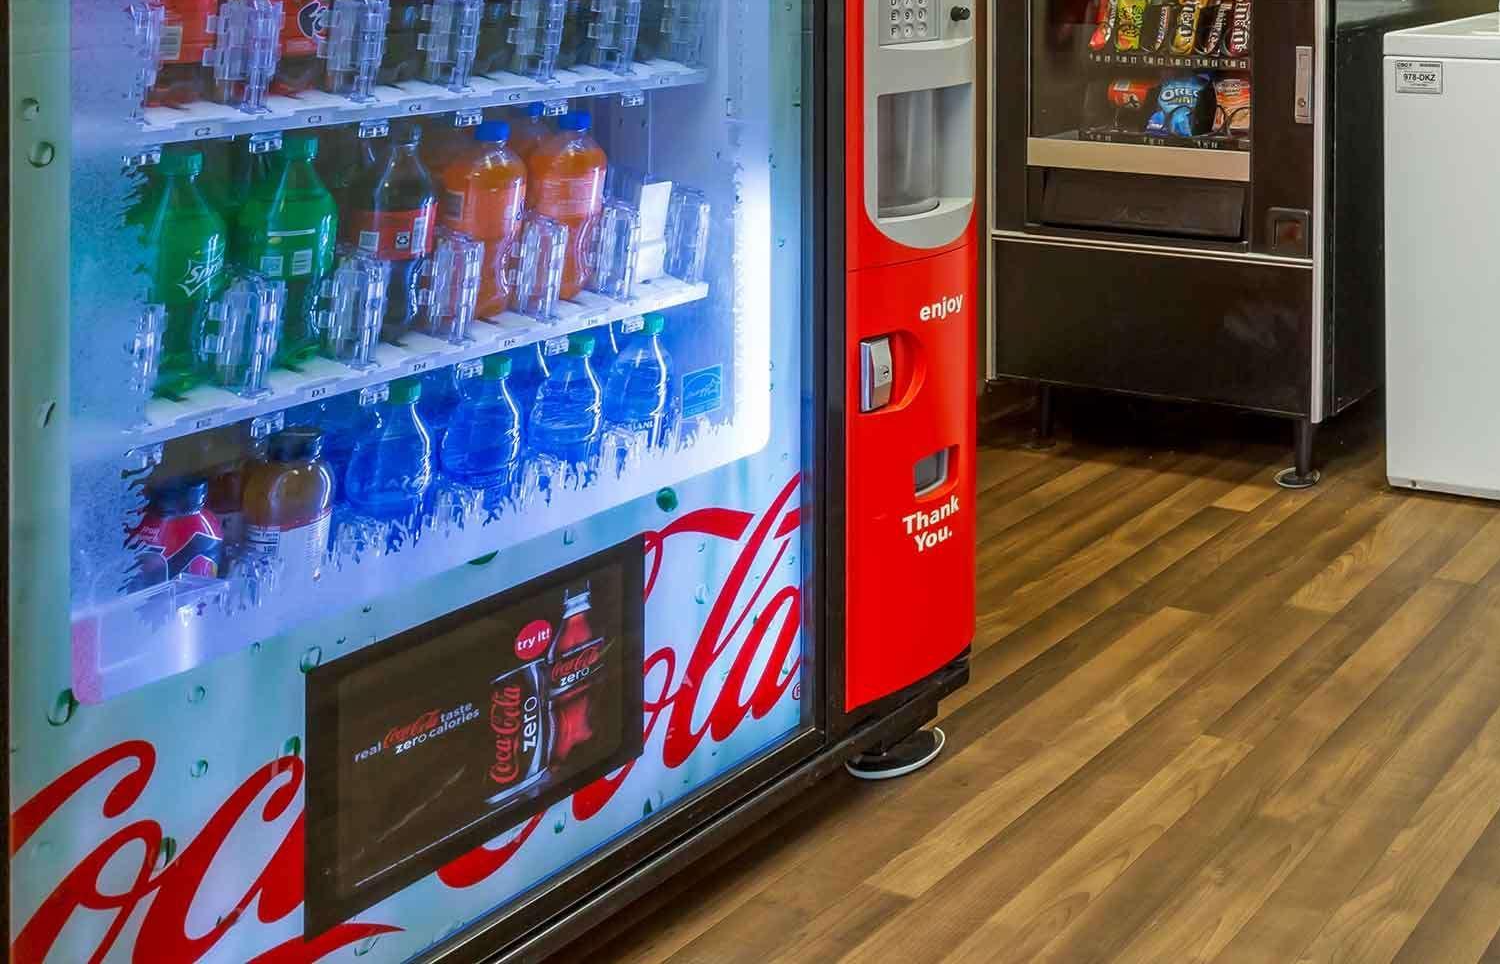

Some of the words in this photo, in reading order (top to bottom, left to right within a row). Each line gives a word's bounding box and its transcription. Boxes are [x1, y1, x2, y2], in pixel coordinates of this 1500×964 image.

[1402, 73, 1436, 82] 978-DKZ
[508, 93, 521, 101] C5
[584, 85, 596, 93] C6
[409, 103, 422, 112] C4
[307, 115, 322, 124] C3
[194, 126, 211, 136] C2
[184, 257, 224, 285] Spri
[919, 293, 964, 321] enjoy
[503, 338, 516, 348] D5
[412, 362, 427, 372] D4
[311, 387, 326, 397] D3
[902, 494, 960, 535] Thank
[914, 524, 953, 553] You.
[516, 635, 536, 652] try
[537, 628, 551, 642] it!
[560, 667, 590, 687] zero
[353, 740, 381, 763] real
[440, 702, 473, 723] taste
[394, 733, 427, 755] zero
[428, 708, 480, 738] calories
[489, 684, 521, 784] Coca-Cola
[523, 695, 537, 753] zero
